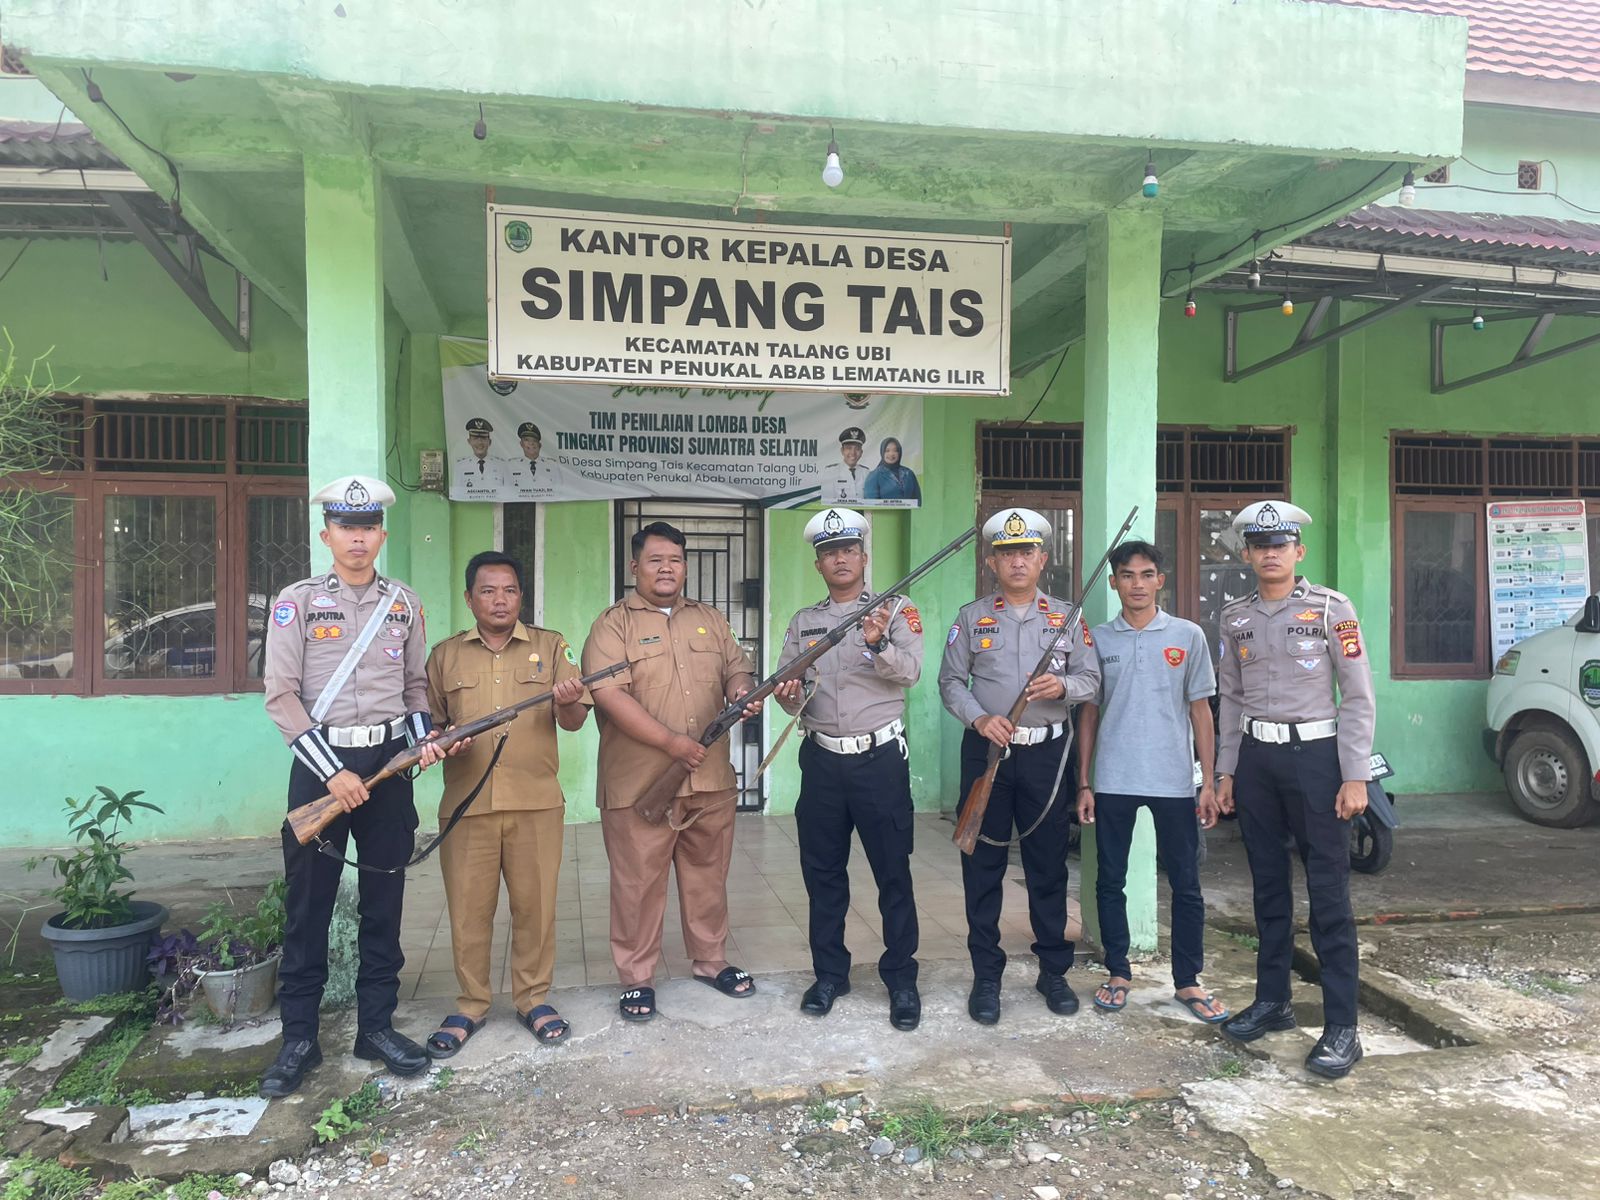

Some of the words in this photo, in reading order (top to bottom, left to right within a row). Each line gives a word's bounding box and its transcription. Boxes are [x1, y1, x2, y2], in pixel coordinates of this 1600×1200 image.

[560, 227, 710, 261] KANTOR
[721, 238, 854, 268] KEPALA
[864, 245, 950, 273] DESA
[520, 266, 825, 332] SIMPANG
[846, 284, 984, 338] TAIS
[625, 336, 760, 357] KECAMATAN
[765, 342, 850, 360] TALANG
[855, 346, 891, 362] UBI
[516, 354, 653, 375] KABUPATEN
[660, 359, 763, 379] PENUKAL
[768, 364, 826, 381] ABAB
[832, 366, 941, 384] LEMATANG
[947, 369, 986, 385] ILIR
[588, 411, 617, 431] TIM
[621, 412, 694, 433] PENILAIAN
[698, 414, 748, 434] LOMBA
[751, 416, 787, 435] DESA
[555, 431, 615, 452] TINGKAT
[619, 435, 684, 455] PROVINSI
[687, 437, 756, 456] SUMATRA
[759, 438, 818, 457] SELATAN
[558, 455, 570, 465] Di
[572, 457, 602, 468] Desa
[605, 458, 658, 472] Simpang
[660, 459, 684, 470] Tais
[686, 461, 754, 473] Kecamatan
[757, 463, 796, 476] Talang
[798, 463, 819, 475] Ubi,
[580, 469, 644, 483] Kabupaten
[646, 472, 692, 483] Penukal
[694, 473, 726, 484] Abab
[728, 475, 787, 489] Lematang
[789, 476, 803, 487] Ilir
[973, 626, 1000, 636] FADHLI
[1287, 626, 1324, 637] POLRI
